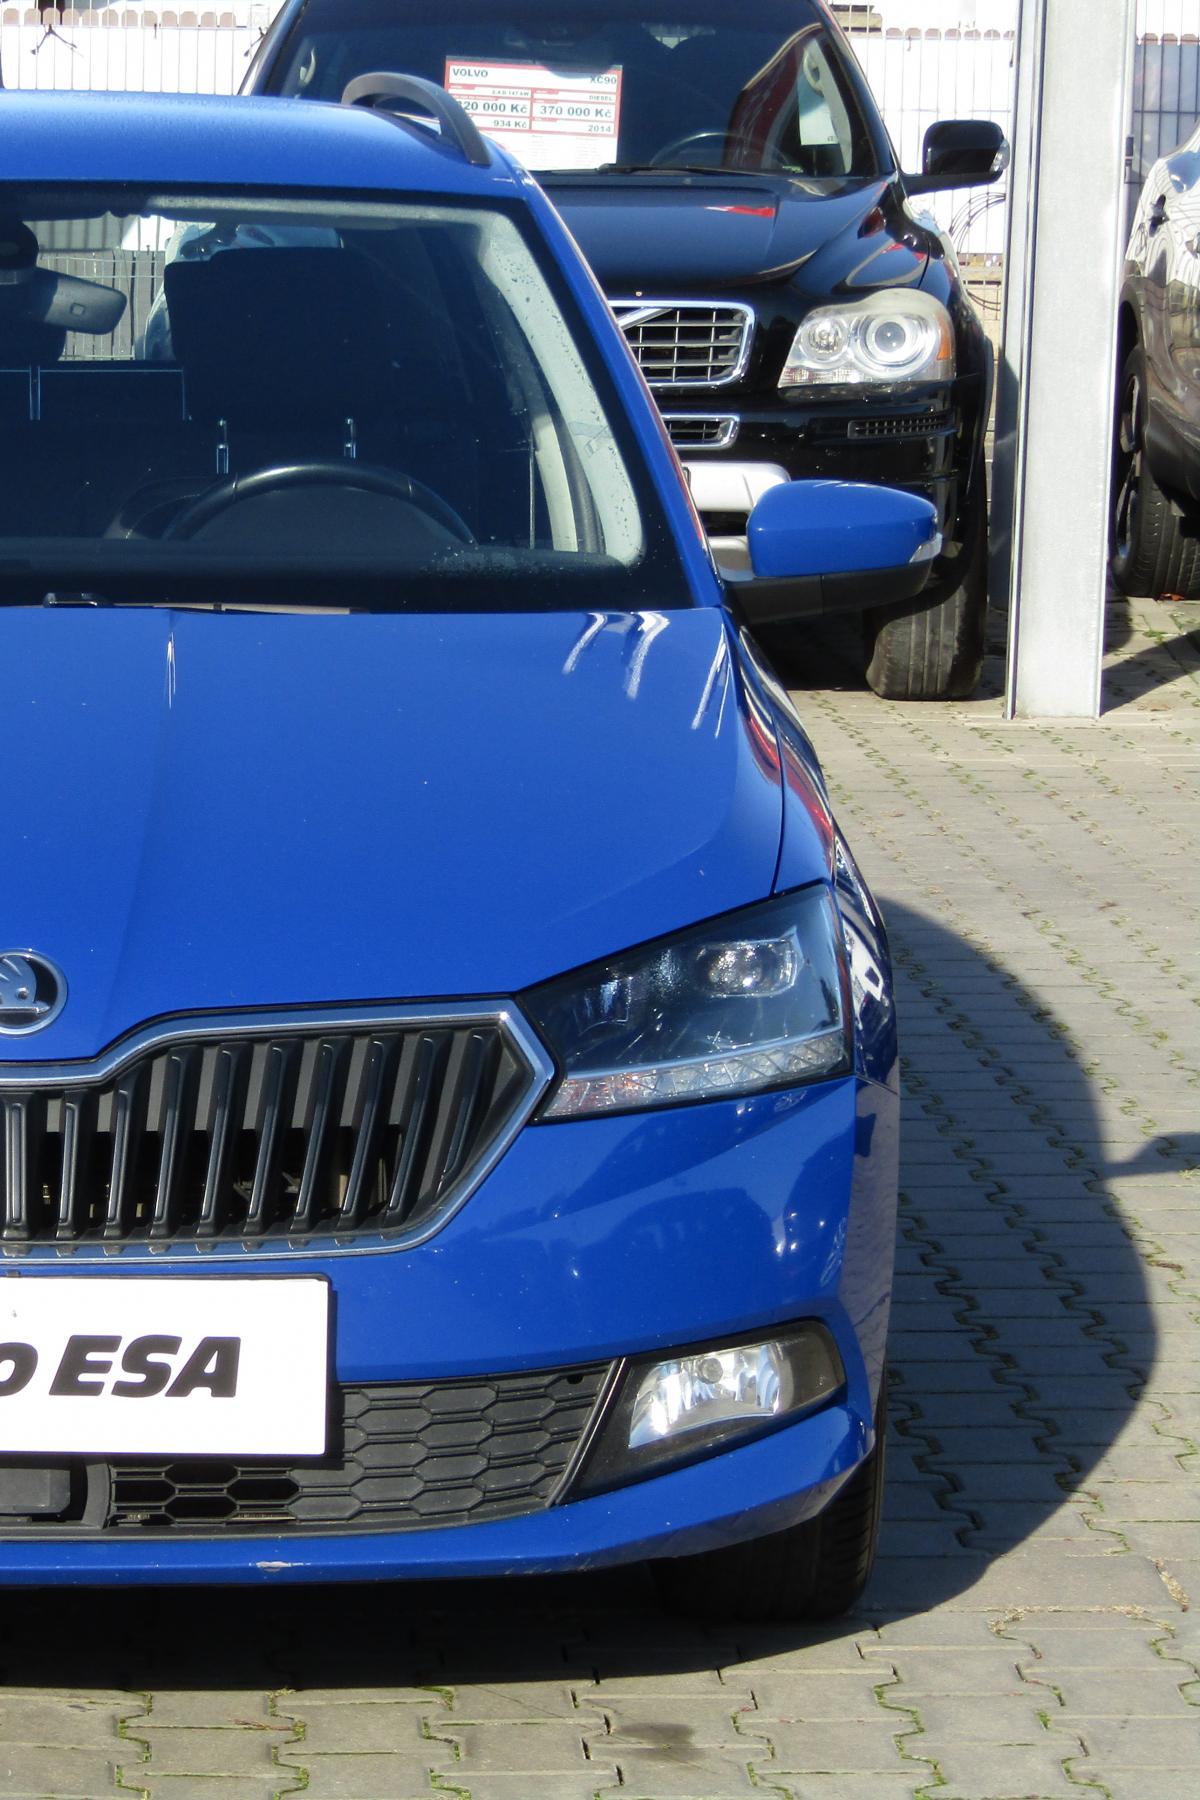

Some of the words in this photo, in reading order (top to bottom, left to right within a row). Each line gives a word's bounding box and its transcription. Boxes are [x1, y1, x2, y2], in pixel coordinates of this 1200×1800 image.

[453, 68, 488, 77] VOLVO
[590, 74, 617, 84] XC90
[459, 101, 478, 111] 20
[483, 102, 506, 112] 000
[510, 103, 527, 113] Kč
[540, 105, 563, 115] 370
[567, 107, 590, 116] 000
[595, 108, 612, 118] Kč
[514, 120, 527, 128] Kč
[49, 1335, 241, 1398] ESA
